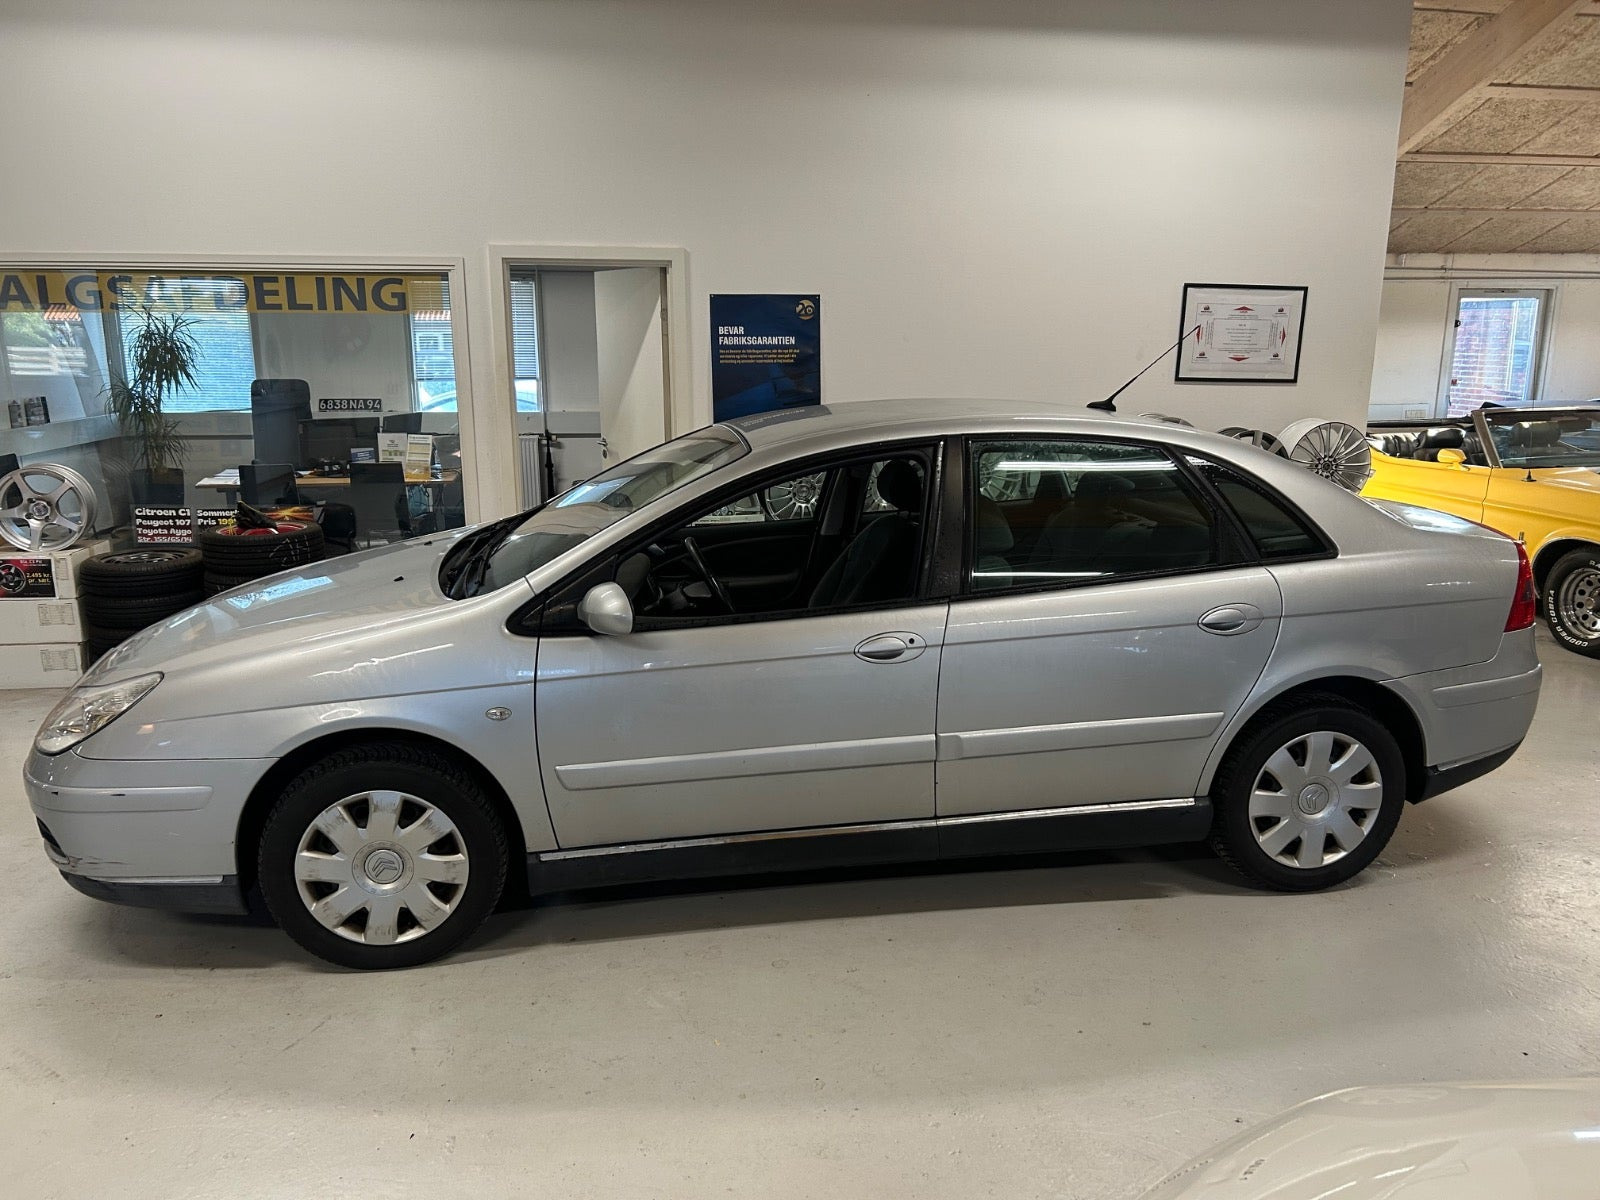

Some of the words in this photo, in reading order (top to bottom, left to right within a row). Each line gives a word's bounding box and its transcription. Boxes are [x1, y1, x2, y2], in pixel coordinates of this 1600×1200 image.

[718, 326, 745, 335] BEVAR
[718, 336, 796, 345] FABRIKSGARANTIEN
[178, 508, 191, 517] C1
[135, 518, 174, 527] Peugeot
[197, 517, 217, 526] Pris
[136, 528, 168, 536] Toyota
[169, 528, 192, 536] Aygo
